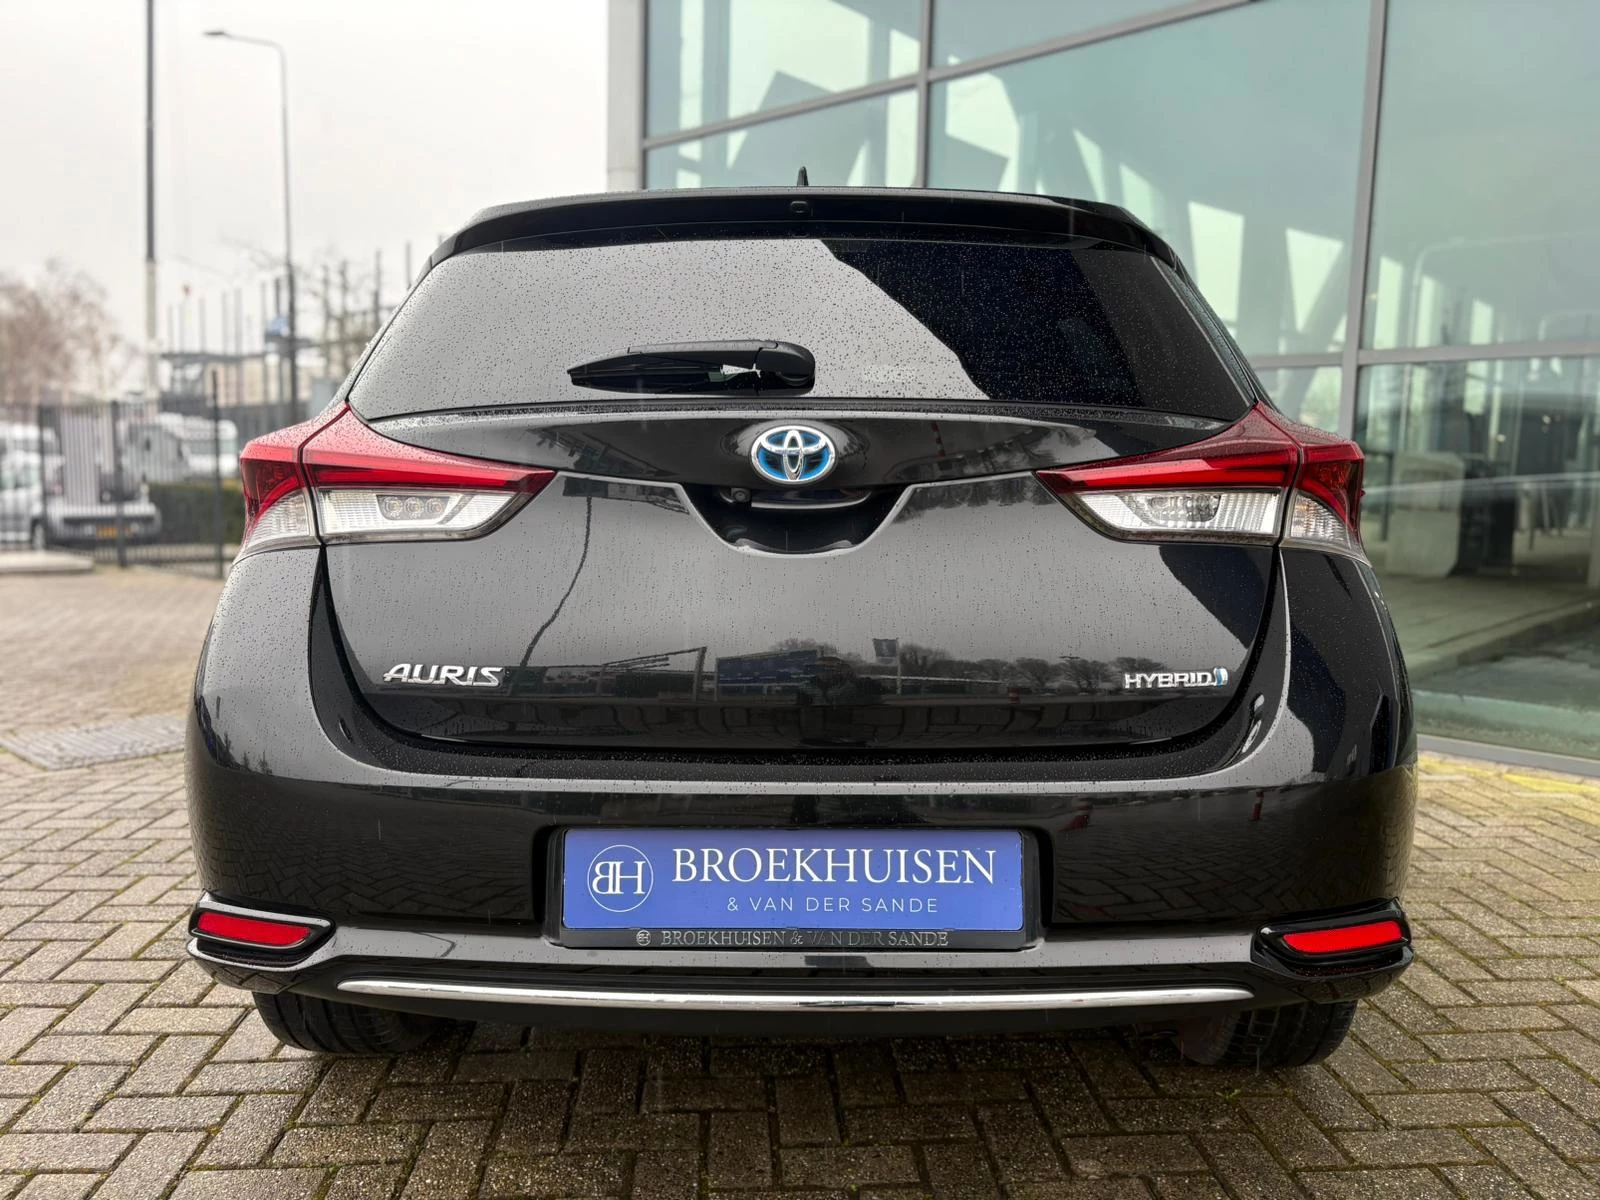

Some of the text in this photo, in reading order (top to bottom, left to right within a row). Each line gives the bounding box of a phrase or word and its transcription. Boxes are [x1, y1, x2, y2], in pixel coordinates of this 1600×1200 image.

[383, 663, 503, 687] AURIS
[1124, 671, 1215, 689] HYBRID
[672, 847, 997, 885] BROEKHUISEN
[727, 896, 938, 913] & VAN DER SANDE
[660, 930, 785, 945] BROEKHUISEN
[790, 931, 803, 945] &
[848, 931, 885, 946] DER
[888, 931, 949, 947] SANDE
